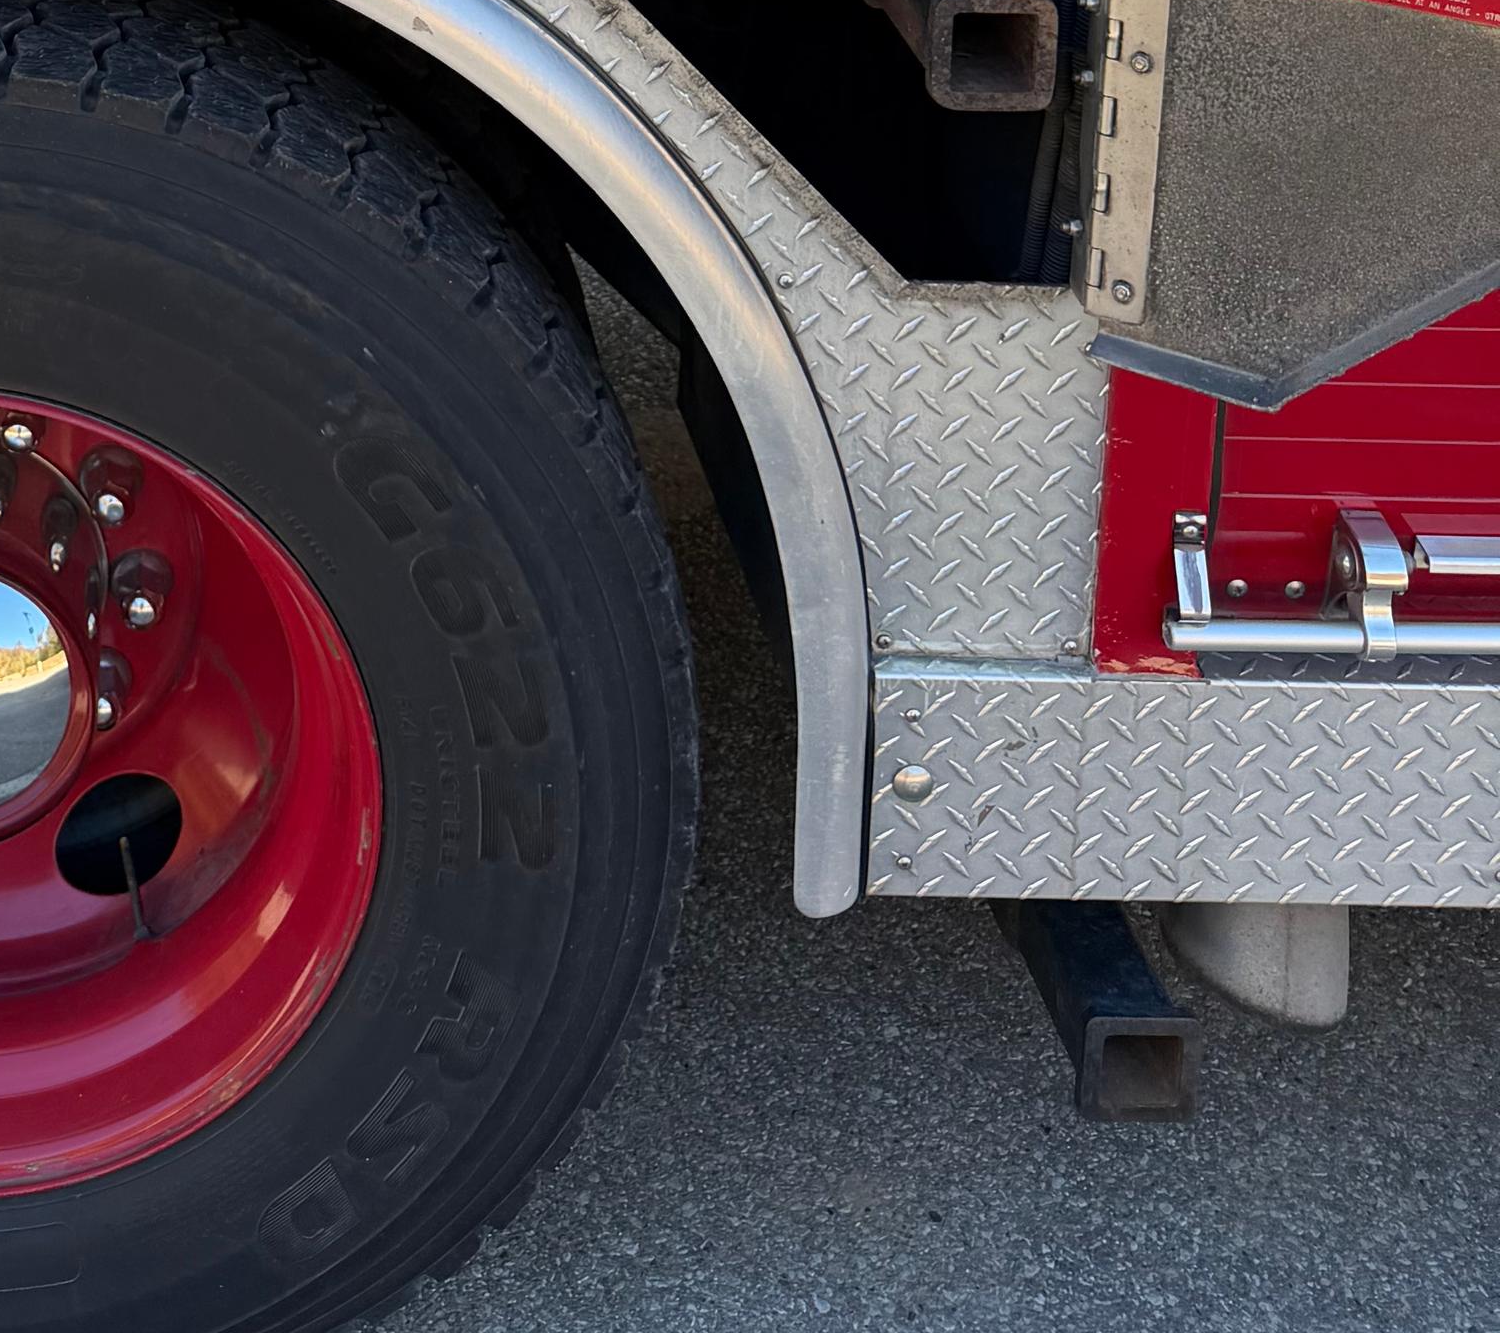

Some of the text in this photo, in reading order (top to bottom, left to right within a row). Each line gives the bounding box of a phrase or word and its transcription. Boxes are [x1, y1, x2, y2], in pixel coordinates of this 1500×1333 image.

[1428, 1, 1441, 10] AN
[1444, 3, 1472, 17] ANGLE
[257, 949, 524, 1261] RSD
